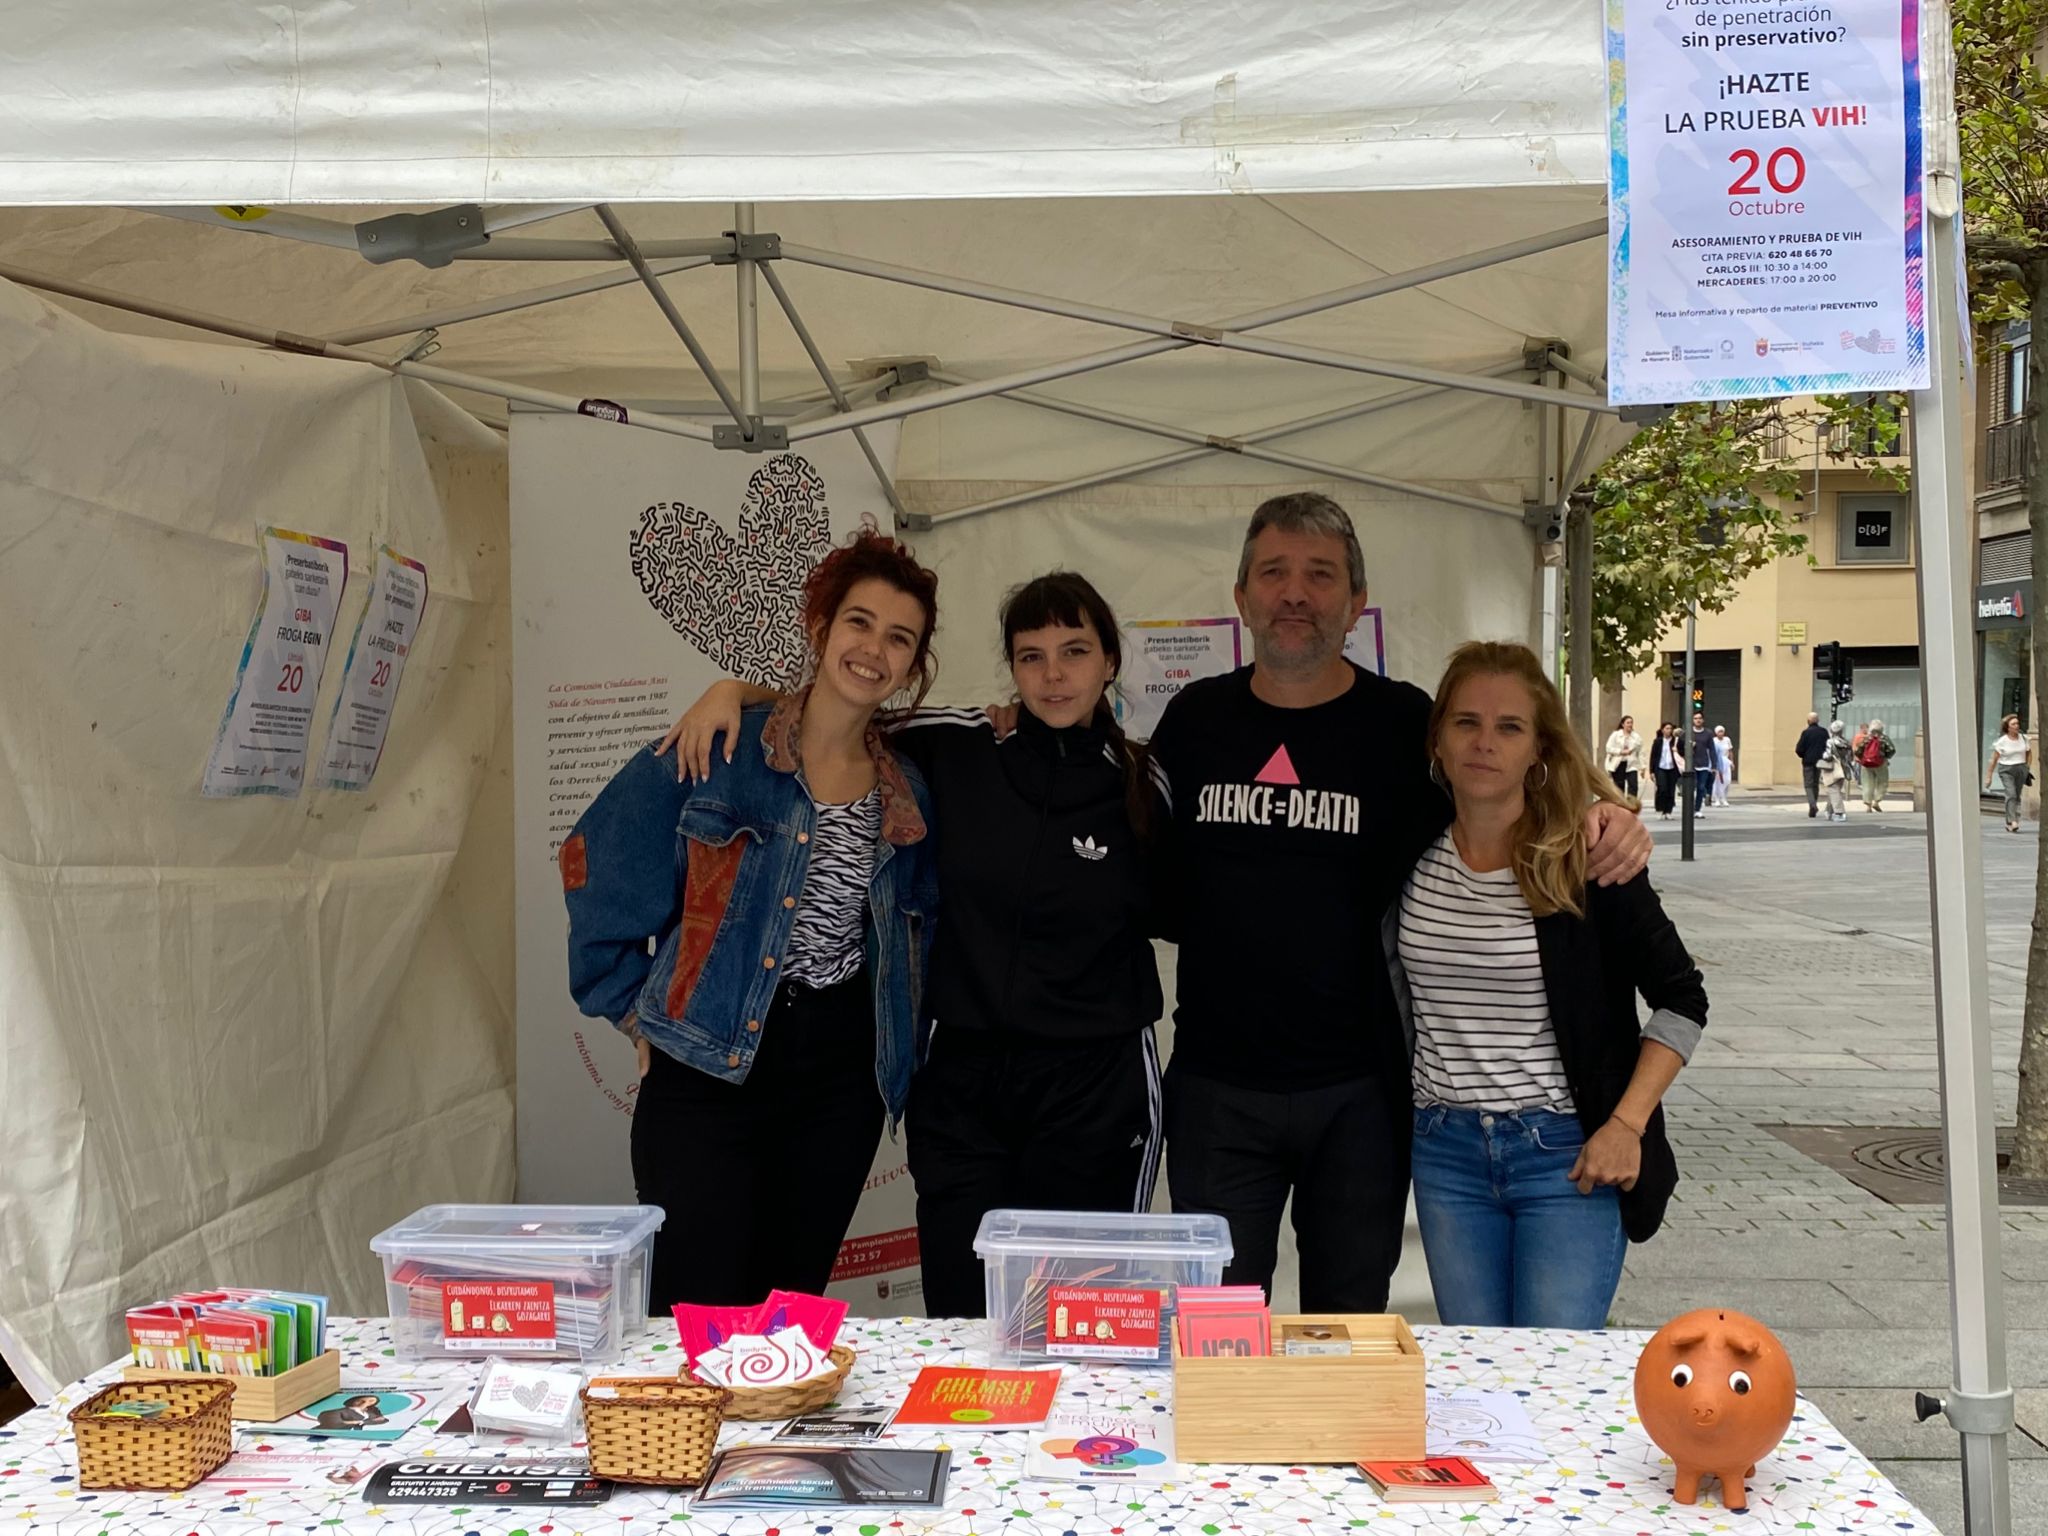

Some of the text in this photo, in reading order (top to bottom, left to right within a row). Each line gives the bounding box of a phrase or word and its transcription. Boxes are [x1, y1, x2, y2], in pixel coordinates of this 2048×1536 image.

[1695, 6, 1831, 30] de penetración
[1682, 27, 1846, 51] sin preservativo?
[1719, 72, 1810, 99] ¡HAZTE
[1665, 105, 1867, 133] LA PRUEBA VIH!
[1728, 147, 1806, 196] 20
[1729, 197, 1806, 217] Octubre
[1672, 231, 1862, 248] ASESORAMIENTO Y PRUEBA DE VIH
[1701, 253, 1723, 262] CITA
[1726, 251, 1765, 261] PREVIA:
[1768, 250, 1787, 259] 620
[1789, 249, 1802, 258] 48
[1820, 248, 1832, 257] 70
[1706, 265, 1747, 275] CARLOS
[1764, 263, 1790, 272] 10:30
[1793, 263, 1799, 271] a
[1801, 261, 1828, 270] 14:00
[1697, 276, 1768, 288] MERCADERES:
[1771, 275, 1796, 284] 17:00
[1807, 274, 1836, 283] 20:00
[1655, 301, 1878, 318] Mesa informativa y reparto de material PREVENTIVO
[295, 608, 312, 622] GIBA
[1979, 597, 2012, 618] helvetia
[277, 626, 321, 646] FROGA EGIN
[1143, 635, 1210, 646] ¿Preserbatiborik
[277, 664, 303, 693] 20
[370, 660, 391, 688] 20
[1165, 669, 1191, 679] GIBA
[548, 684, 561, 693] La
[604, 678, 647, 689] Ciudadana
[1145, 684, 1181, 694] FROGA
[548, 700, 569, 709] Sida
[570, 698, 580, 708] de
[618, 695, 635, 703] nace
[637, 694, 646, 702] en
[649, 691, 668, 701] 1987
[548, 707, 670, 725] con el objetivo de sensibilizar,
[548, 731, 586, 741] prevenir
[595, 727, 622, 739] ofrecer
[624, 722, 671, 735] información
[557, 744, 596, 755] servicios
[599, 742, 619, 752] sobre
[548, 761, 576, 771] salud
[579, 759, 609, 770] sexual
[549, 774, 611, 786] los Derechos
[549, 791, 593, 802] Creando,
[549, 808, 580, 818] años,
[1196, 783, 1360, 834] SILENCE=DEATH
[574, 1032, 603, 1087] anónima,
[837, 1250, 882, 1267] 21 22 57
[496, 1285, 539, 1297] DISFRUTAMOS
[1103, 1292, 1145, 1304] DISFRUTAMOS
[523, 1301, 550, 1311] ZAINTZA
[1128, 1308, 1156, 1319] ZAINTZA
[398, 1463, 591, 1477] CHEMSE
[387, 1486, 459, 1497] 629447325
